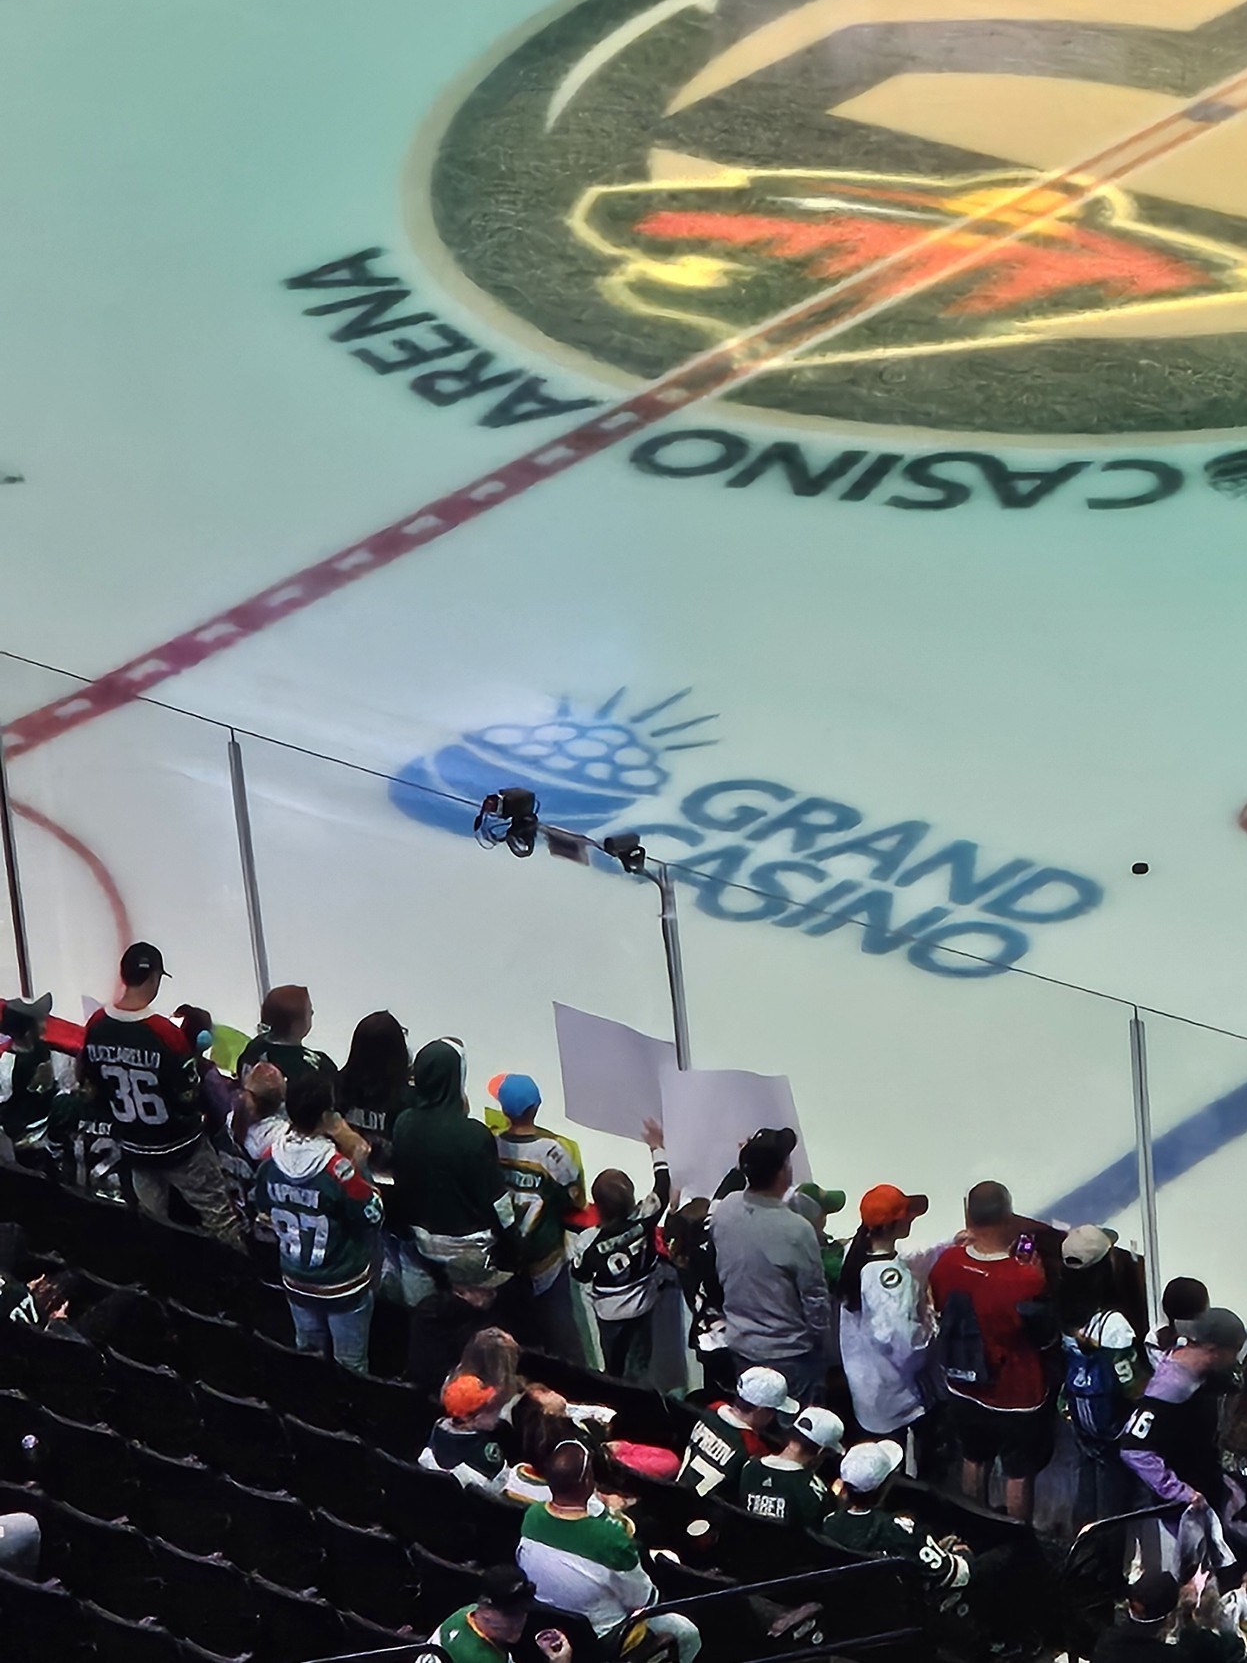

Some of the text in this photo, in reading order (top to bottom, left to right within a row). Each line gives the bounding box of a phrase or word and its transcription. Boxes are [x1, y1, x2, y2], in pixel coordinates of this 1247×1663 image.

[282, 247, 606, 429] ARENA
[629, 427, 1185, 512] CASINO
[681, 778, 1104, 924] GRAND
[101, 1064, 169, 1125] 36
